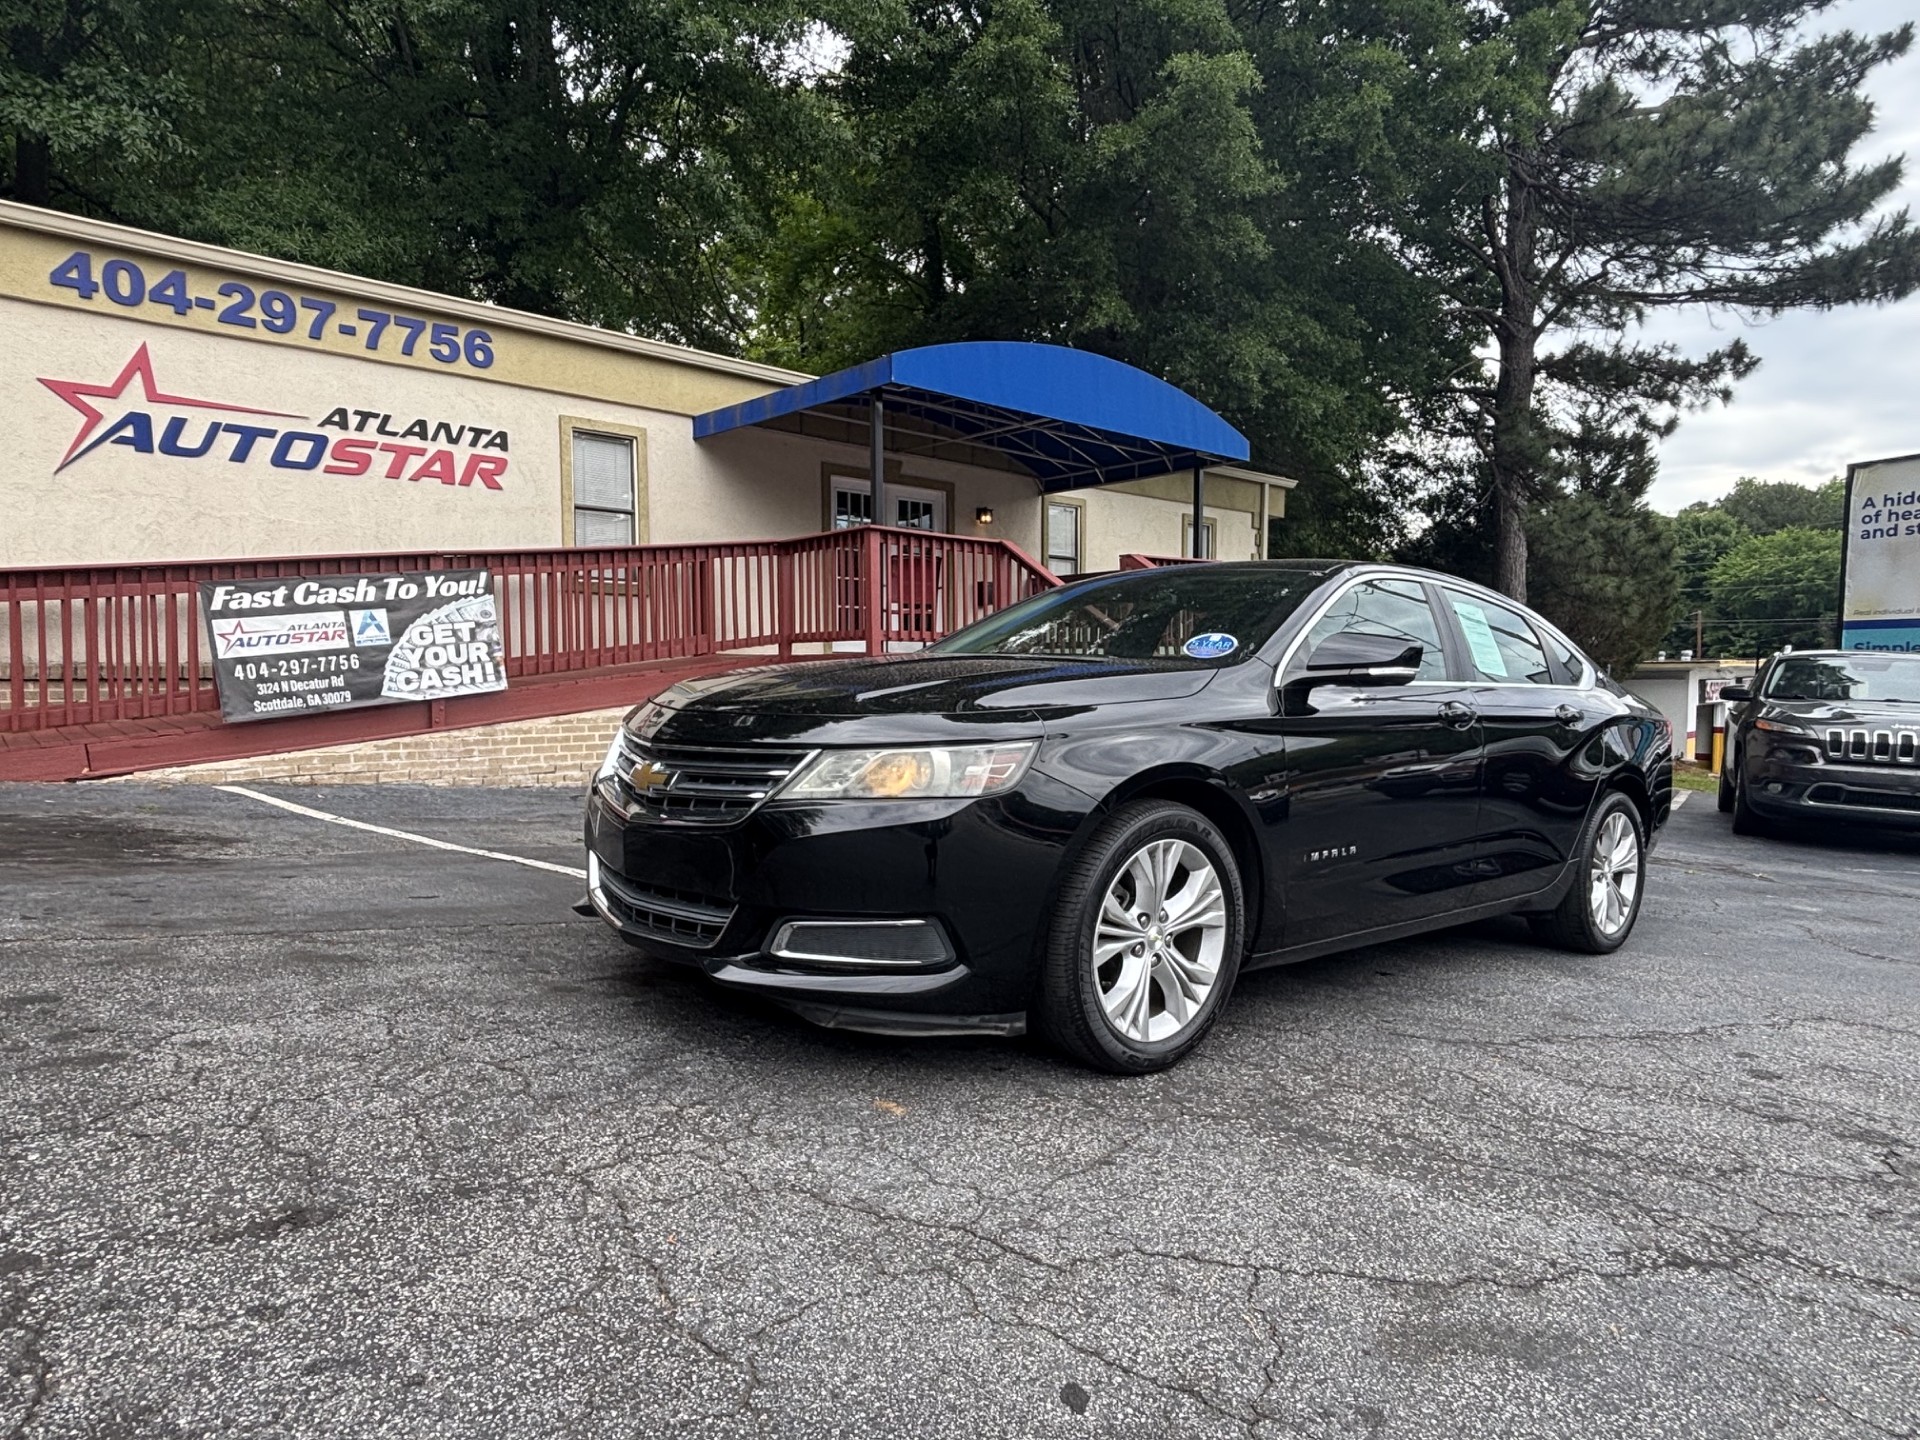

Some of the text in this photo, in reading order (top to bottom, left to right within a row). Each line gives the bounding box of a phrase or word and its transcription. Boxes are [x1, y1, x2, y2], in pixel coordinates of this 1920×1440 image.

[49, 250, 496, 370] 404-297-7756
[317, 406, 510, 452] ATLANTA
[84, 409, 510, 491] AUTOSTAR
[1862, 497, 1876, 509] A
[1861, 509, 1882, 525] of
[1860, 523, 1898, 540] and
[210, 571, 488, 611] Fast Cash To You!
[287, 621, 346, 632] ATLANTA
[410, 621, 476, 646] GET
[229, 629, 346, 649] AUTOSTAR
[234, 653, 360, 680] 404-297-7756
[402, 642, 491, 669] YOUR
[256, 675, 345, 695] 3124 N Decatur Rd
[396, 661, 497, 692] CASH!
[253, 691, 352, 713] Scottdale, GA 30079
[1303, 845, 1357, 863] IMPALA
